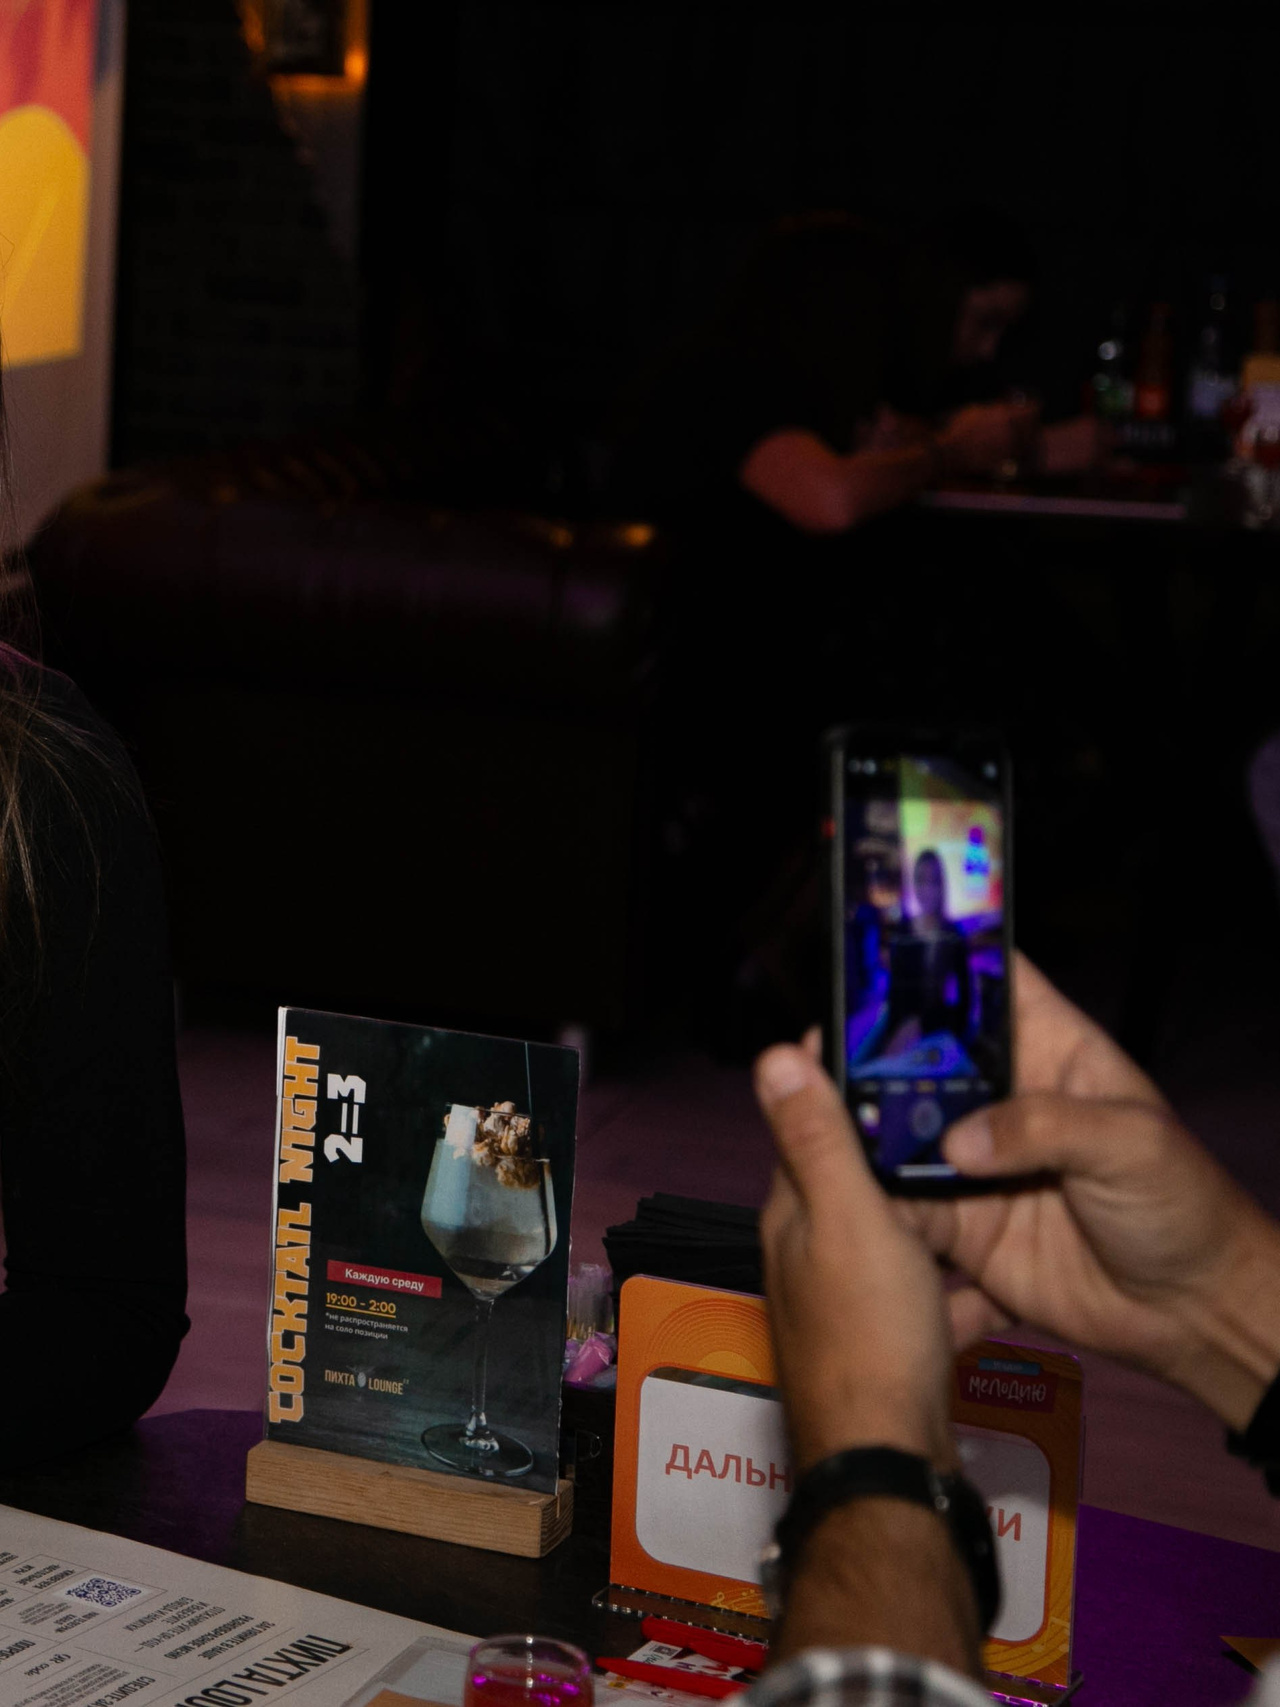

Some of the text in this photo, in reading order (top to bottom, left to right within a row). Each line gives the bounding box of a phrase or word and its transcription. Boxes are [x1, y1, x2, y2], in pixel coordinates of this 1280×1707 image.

[323, 1073, 367, 1163] 2=3
[269, 1036, 320, 1423] COCKTAIL NIGHT
[345, 1268, 424, 1292] Каждую среду
[326, 1292, 357, 1308] 19:00
[369, 1299, 397, 1314] 2:00
[336, 1325, 353, 1334] соло
[355, 1329, 388, 1340] позиции
[340, 1314, 408, 1333] распространяется
[325, 1369, 403, 1395] ПИХТА LOUNGE
[665, 1443, 792, 1493] ДАЛЬН
[172, 1634, 354, 1707] ПИХТА LOU
[102, 1675, 158, 1701] СЛЕДИТЕ
